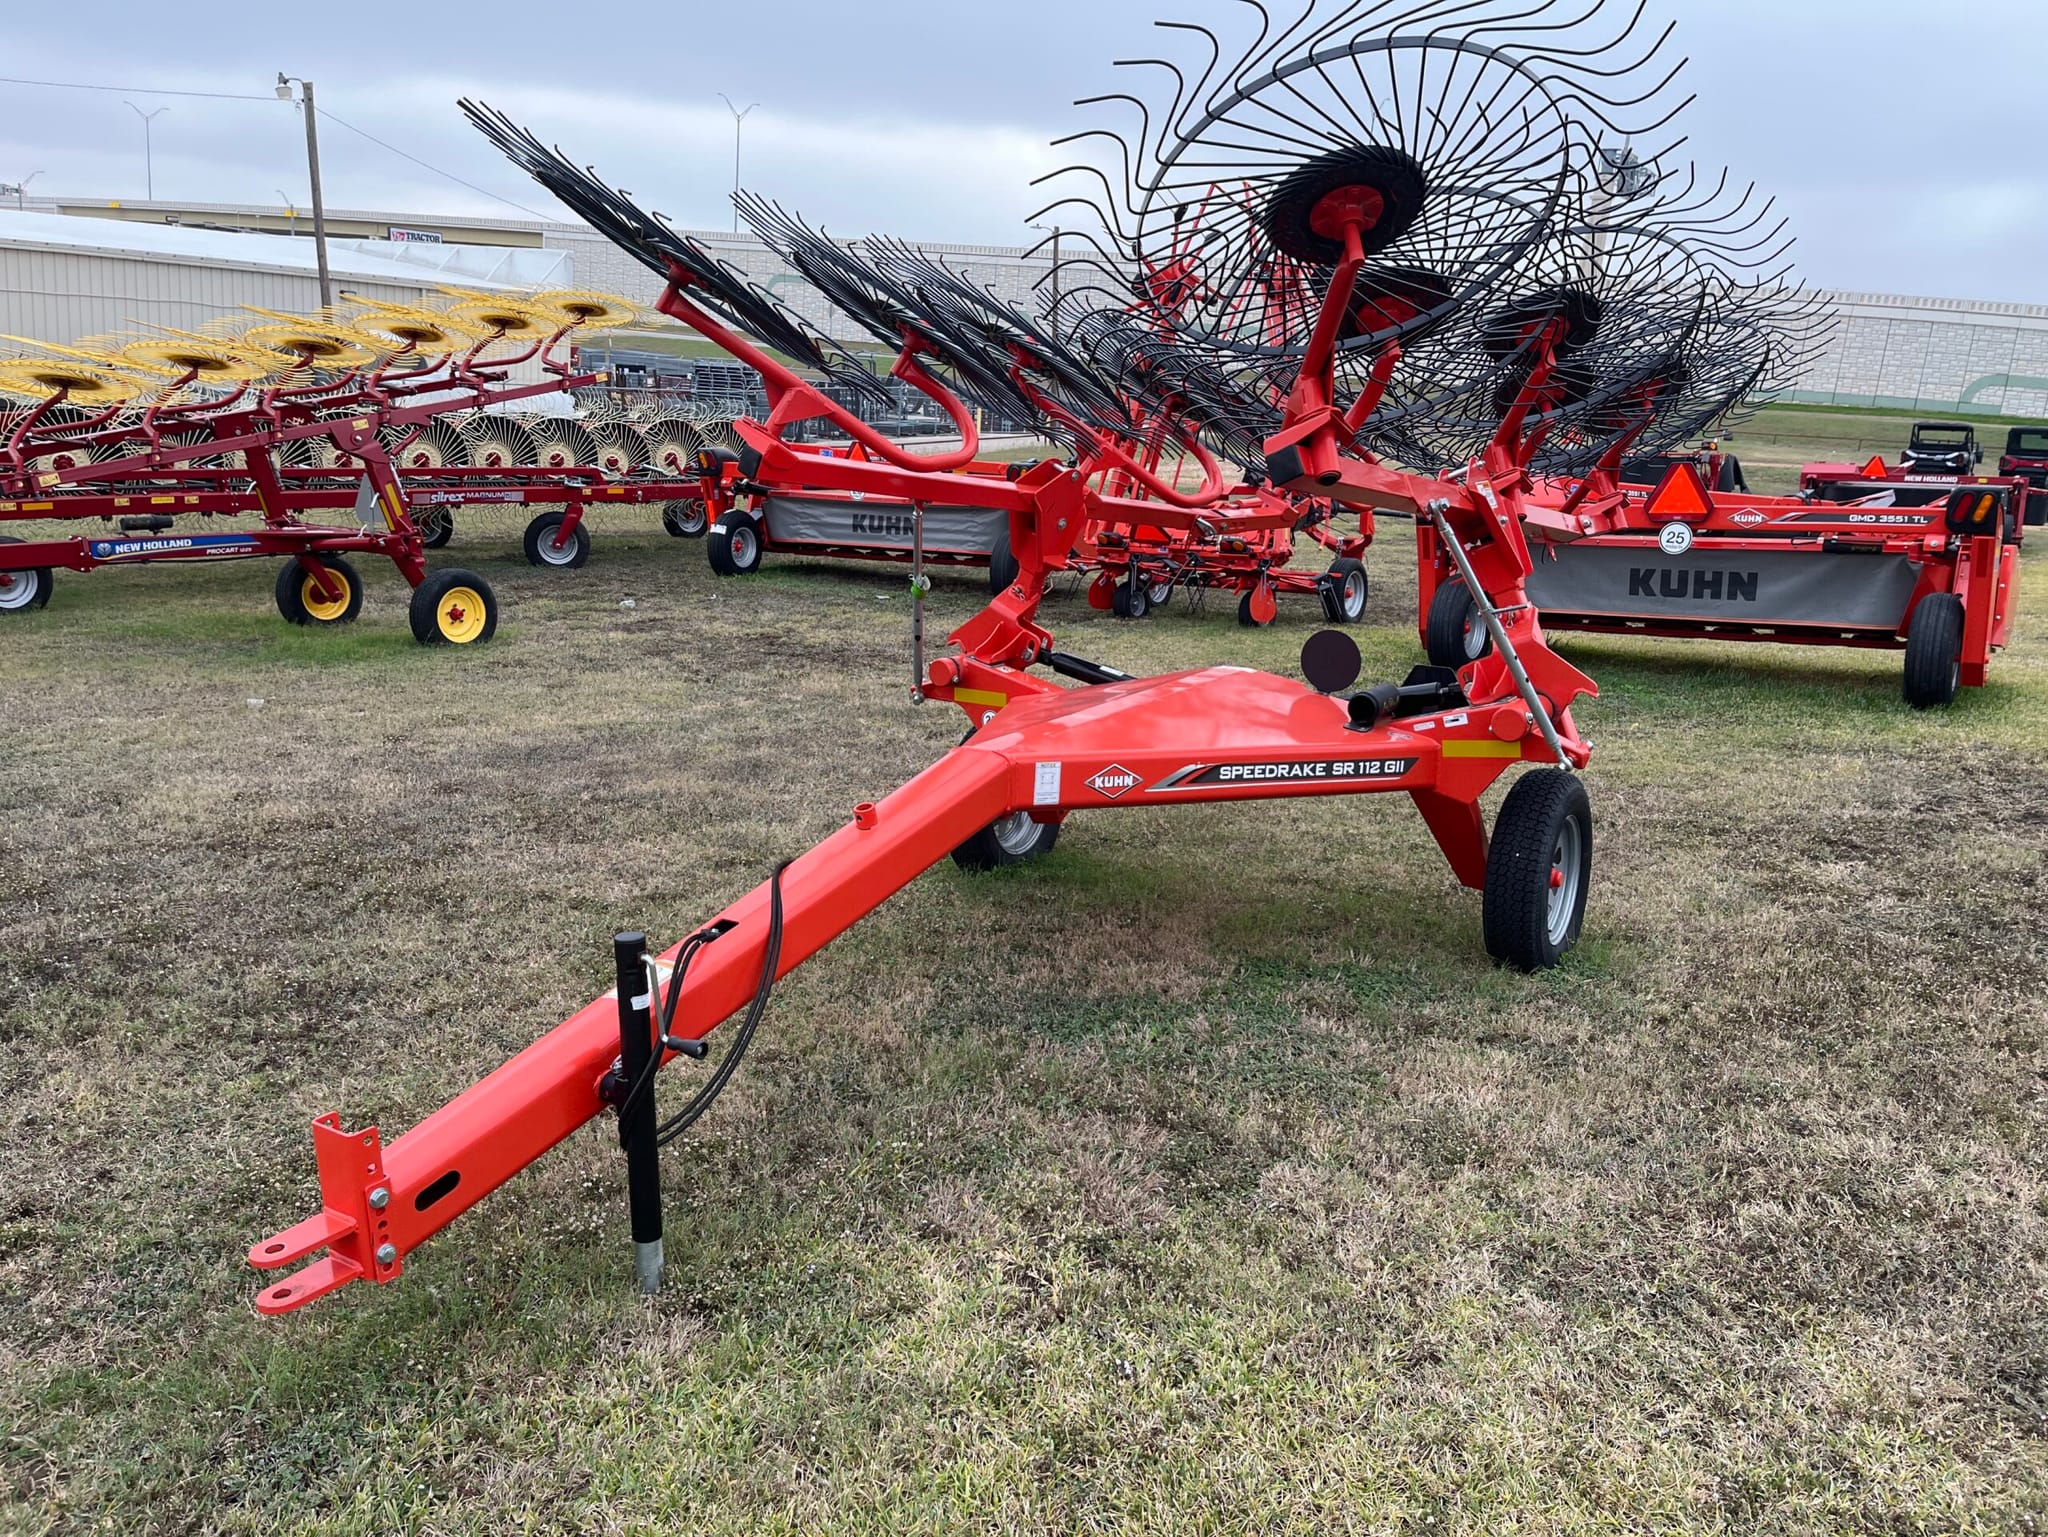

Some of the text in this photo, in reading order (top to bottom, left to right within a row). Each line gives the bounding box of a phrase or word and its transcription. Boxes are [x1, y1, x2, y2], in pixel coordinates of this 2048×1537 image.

[406, 231, 440, 243] TRACTOR
[1923, 475, 1958, 483] HOLLAND
[466, 491, 504, 499] MAGNUM
[1734, 513, 1763, 523] KUHN
[1849, 514, 1928, 523] GMD 3551 TL
[1665, 531, 1686, 544] 25
[115, 538, 192, 553] NEW HOLLAND
[206, 547, 238, 555] PROCART
[1629, 567, 1759, 602] KUHN
[1219, 760, 1405, 779] SPEEDRAKE SR 112 GII
[1094, 775, 1133, 788] KUHN
